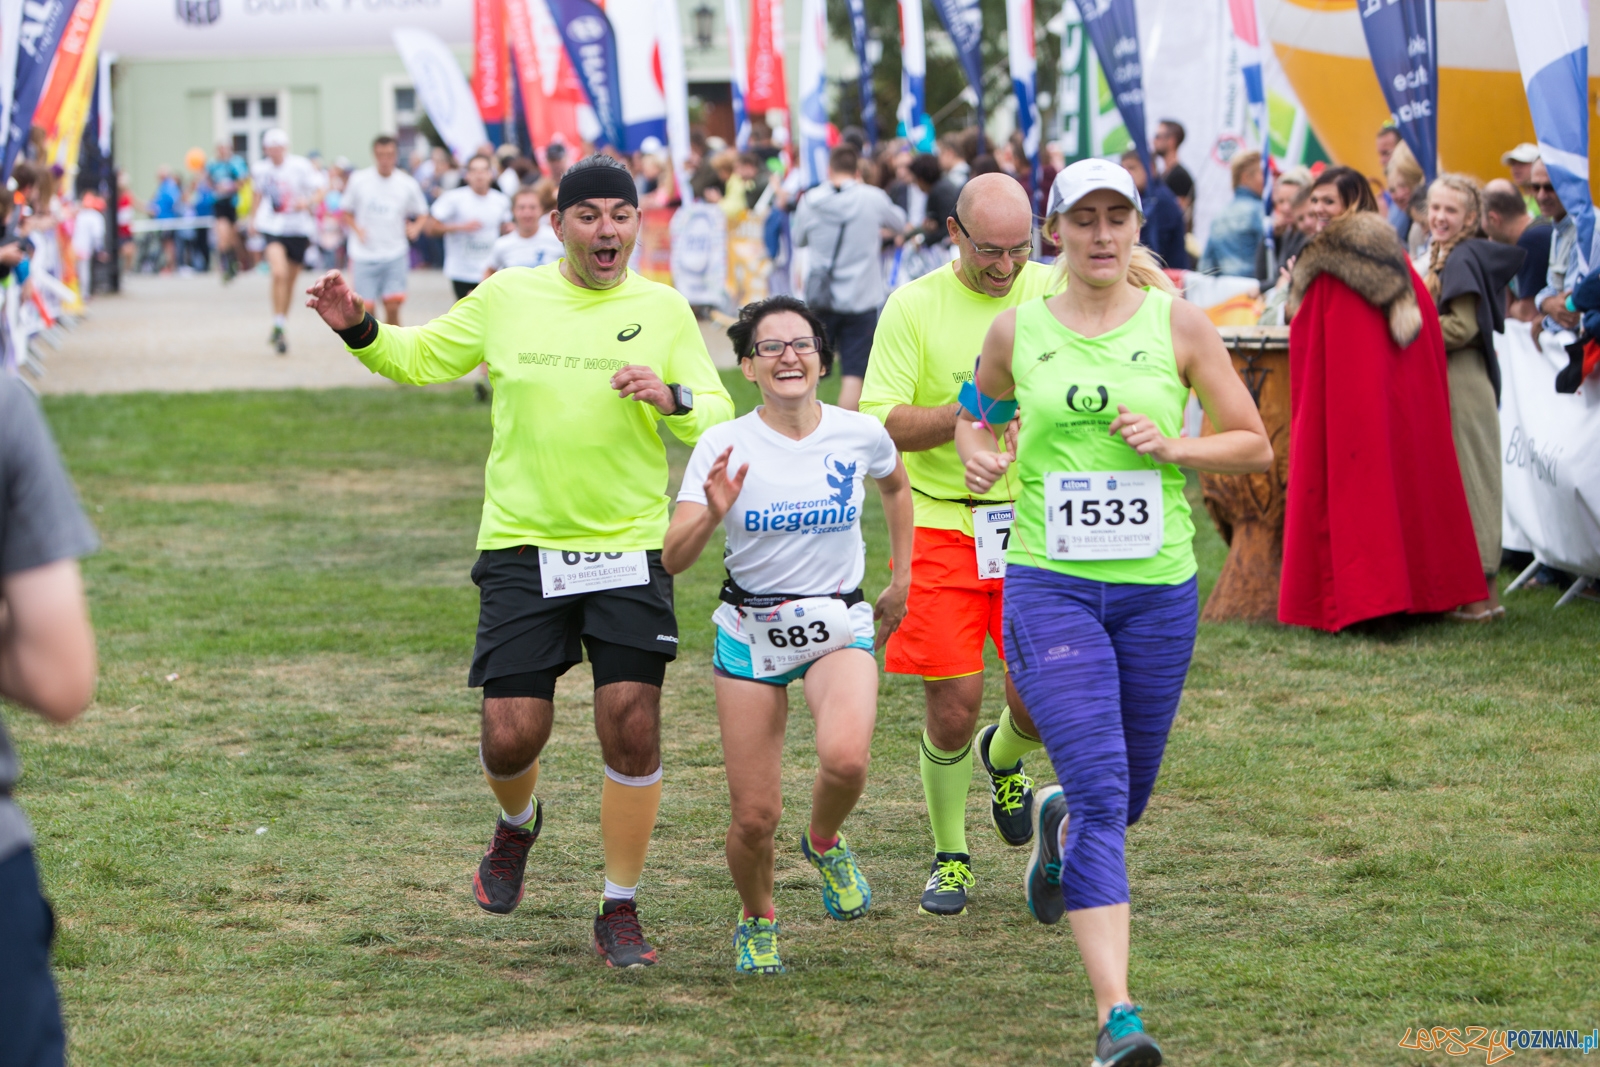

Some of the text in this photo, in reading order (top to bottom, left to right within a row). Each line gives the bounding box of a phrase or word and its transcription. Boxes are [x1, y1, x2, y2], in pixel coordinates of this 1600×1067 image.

[518, 353, 561, 366] WANT
[564, 356, 580, 368] IT
[771, 499, 834, 512] Wieczorne
[1059, 498, 1149, 526] 1533
[745, 505, 857, 532] Bieganie
[1084, 535, 1106, 543] BIEG
[567, 573, 577, 581] 39
[579, 570, 597, 579] BIEG
[599, 565, 637, 576] LECHITÓW
[768, 620, 829, 648] 683
[776, 655, 786, 663] 39
[787, 653, 806, 662] BIEG
